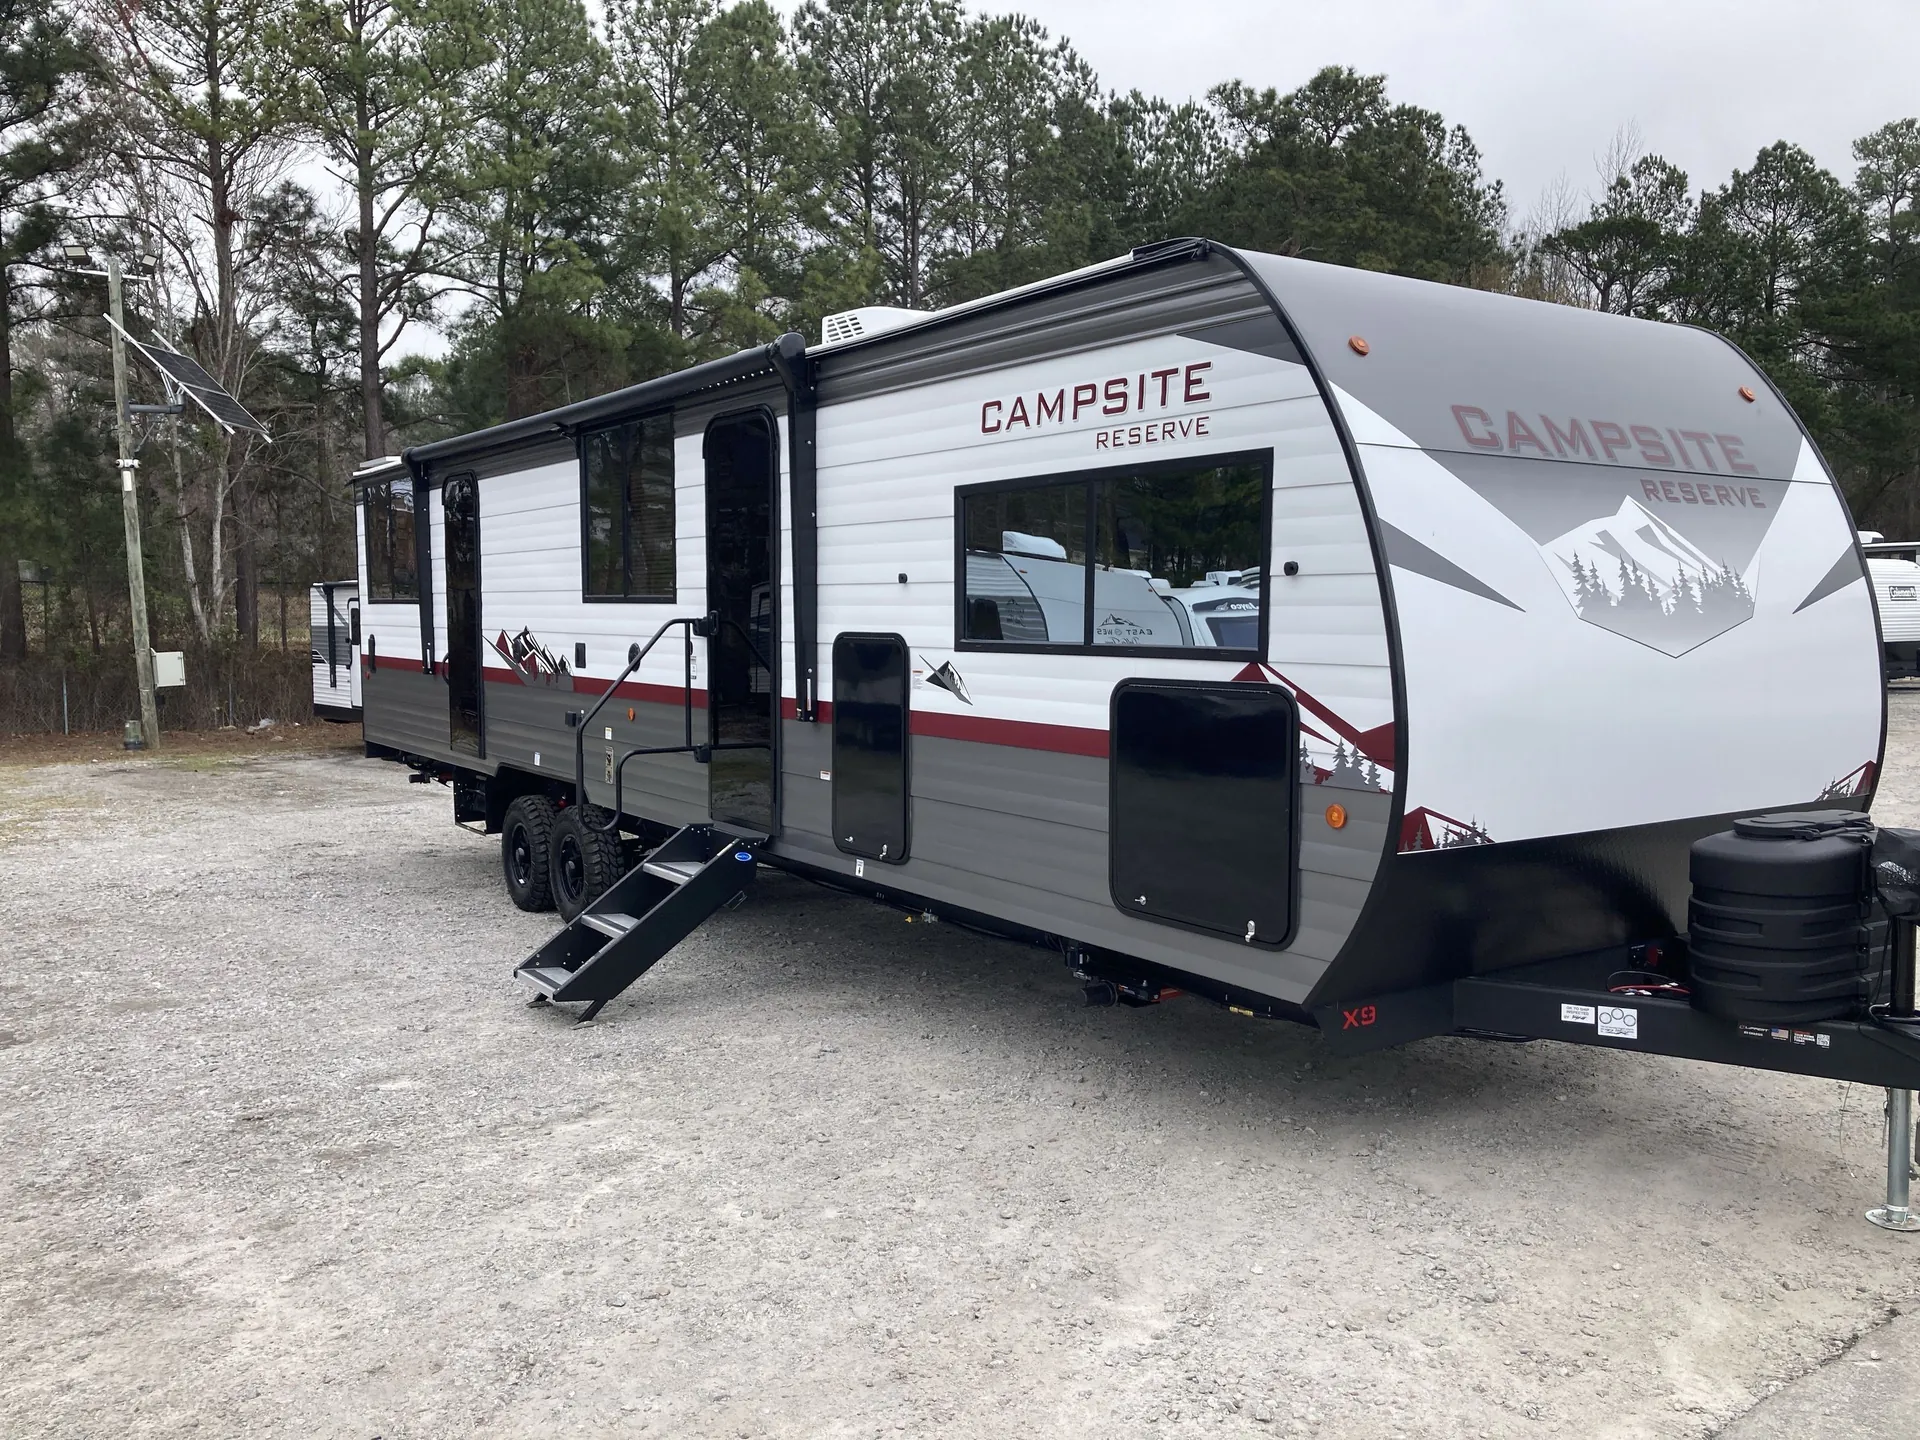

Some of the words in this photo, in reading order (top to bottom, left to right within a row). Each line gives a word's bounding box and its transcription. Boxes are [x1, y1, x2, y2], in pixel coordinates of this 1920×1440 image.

[982, 361, 1212, 434] CAMPSITE
[1096, 416, 1210, 450] RESERVE
[1451, 404, 1759, 475] CAMPSITE
[1640, 478, 1768, 508] RESERVE
[1342, 1005, 1376, 1030] X9
